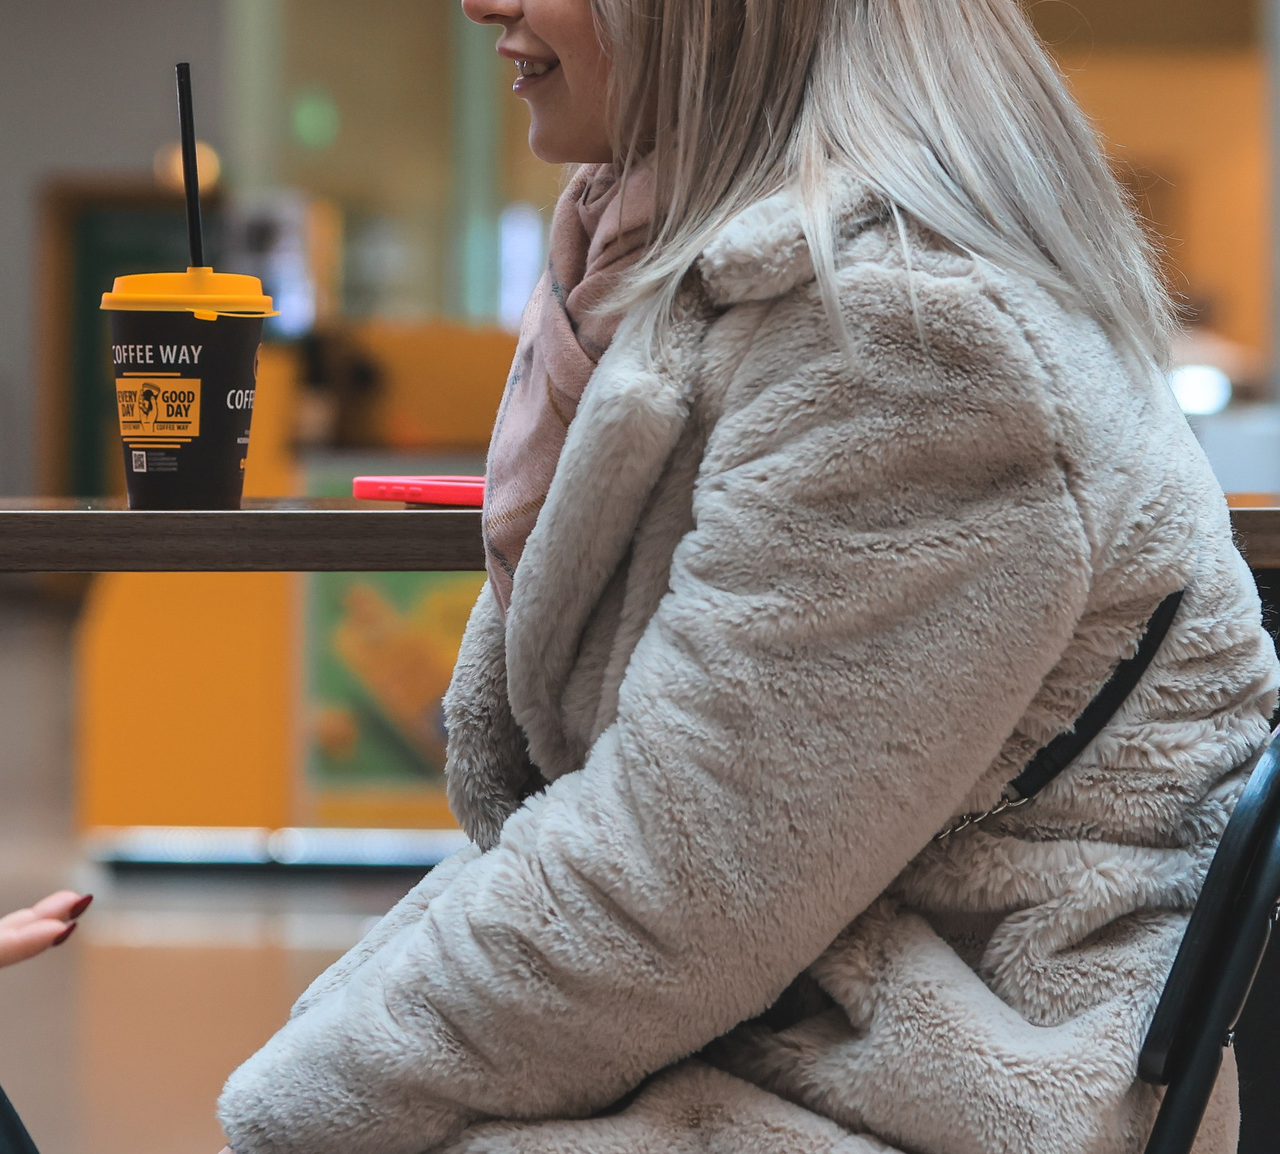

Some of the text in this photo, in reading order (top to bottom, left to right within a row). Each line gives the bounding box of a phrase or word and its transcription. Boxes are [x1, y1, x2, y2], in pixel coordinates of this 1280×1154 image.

[159, 344, 202, 364] WAY
[118, 390, 137, 403] EVERY
[161, 390, 195, 403] GOOD
[226, 389, 255, 409] COFF
[121, 404, 135, 417] DAY
[166, 404, 191, 417] DAY
